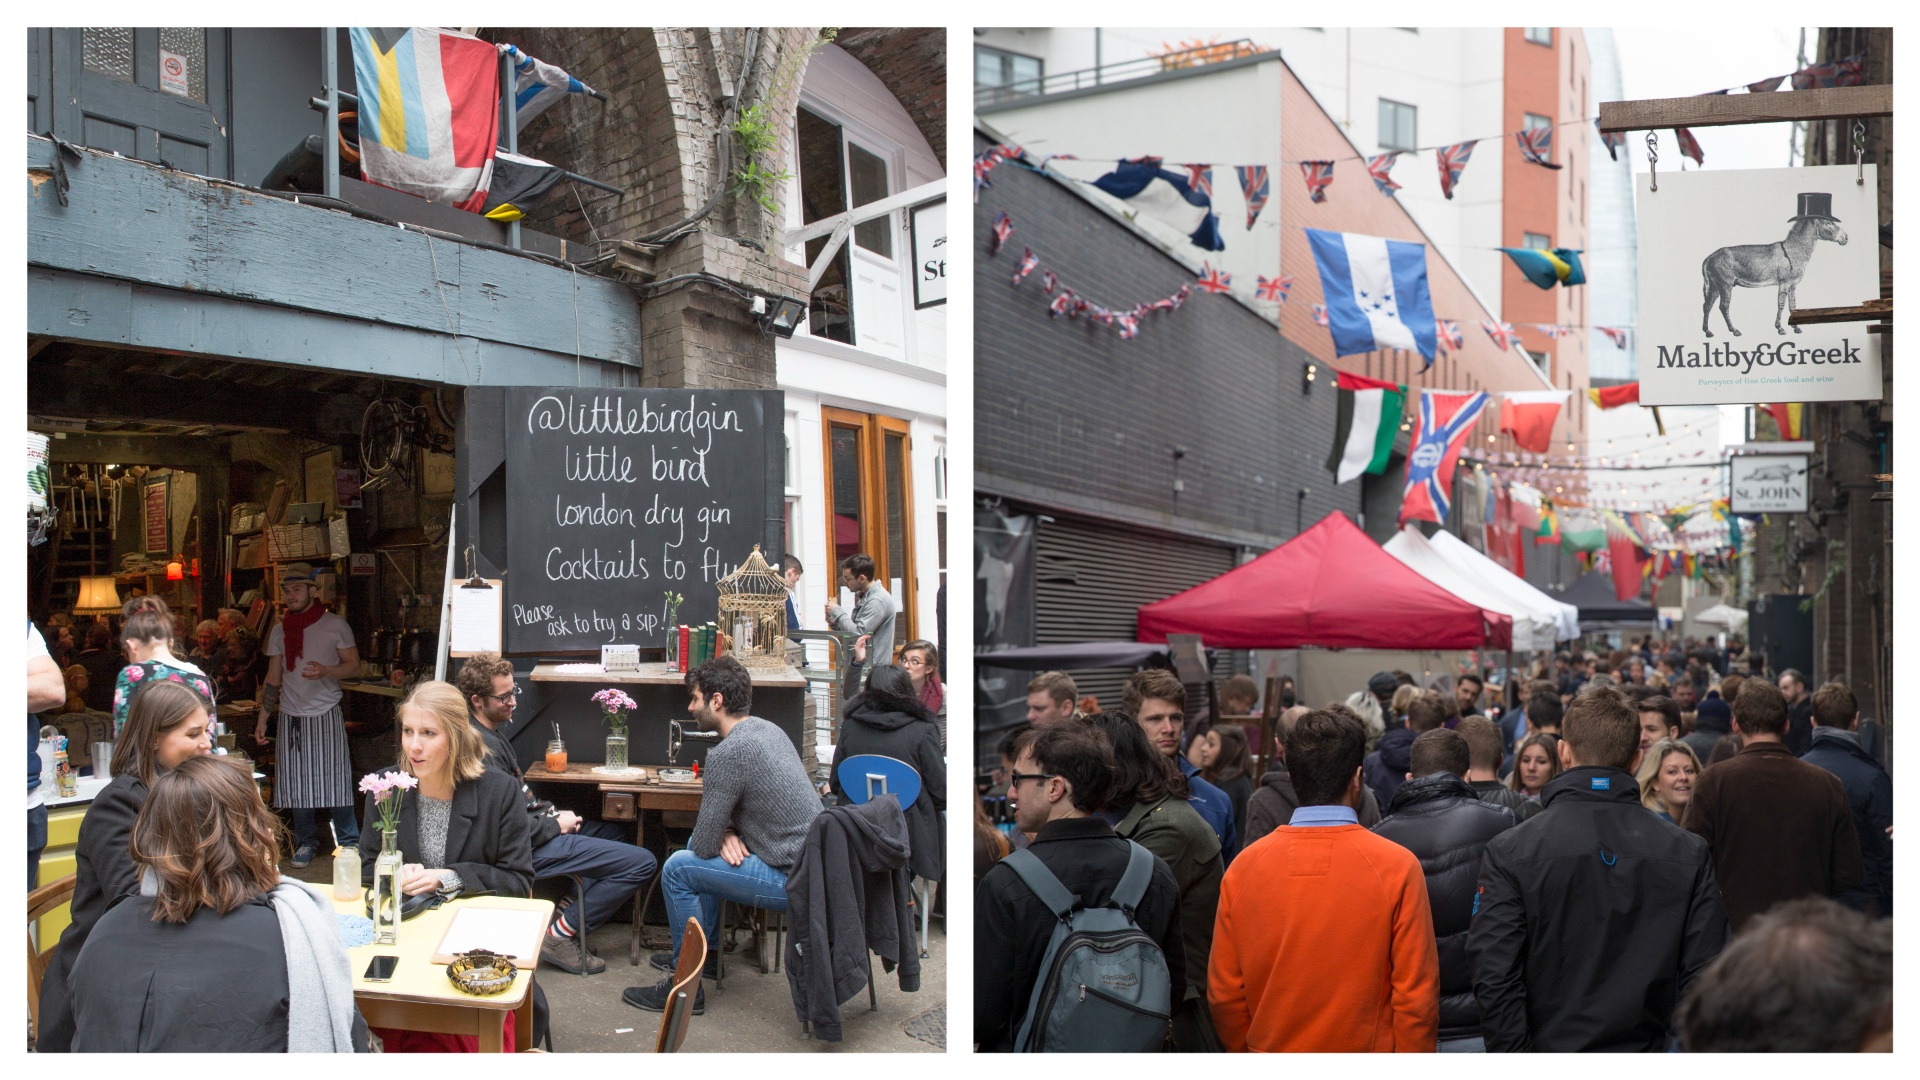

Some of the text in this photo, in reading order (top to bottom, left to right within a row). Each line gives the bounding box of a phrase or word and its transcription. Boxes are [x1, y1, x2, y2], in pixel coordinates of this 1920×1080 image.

[1656, 338, 1862, 374] Maltby&Greek
[1698, 378, 1733, 387] Purveyors
[1760, 376, 1782, 384] Greek
[528, 395, 743, 455] @littlebirdgin
[565, 445, 710, 487] little bird
[1757, 486, 1802, 499] JOHN
[557, 492, 731, 548] london dry gin
[546, 539, 649, 581] Cocktails
[663, 545, 686, 580] to
[512, 603, 555, 626] Please
[547, 618, 574, 637] ask
[574, 612, 590, 633] to
[593, 609, 616, 642] try
[622, 613, 631, 631] a
